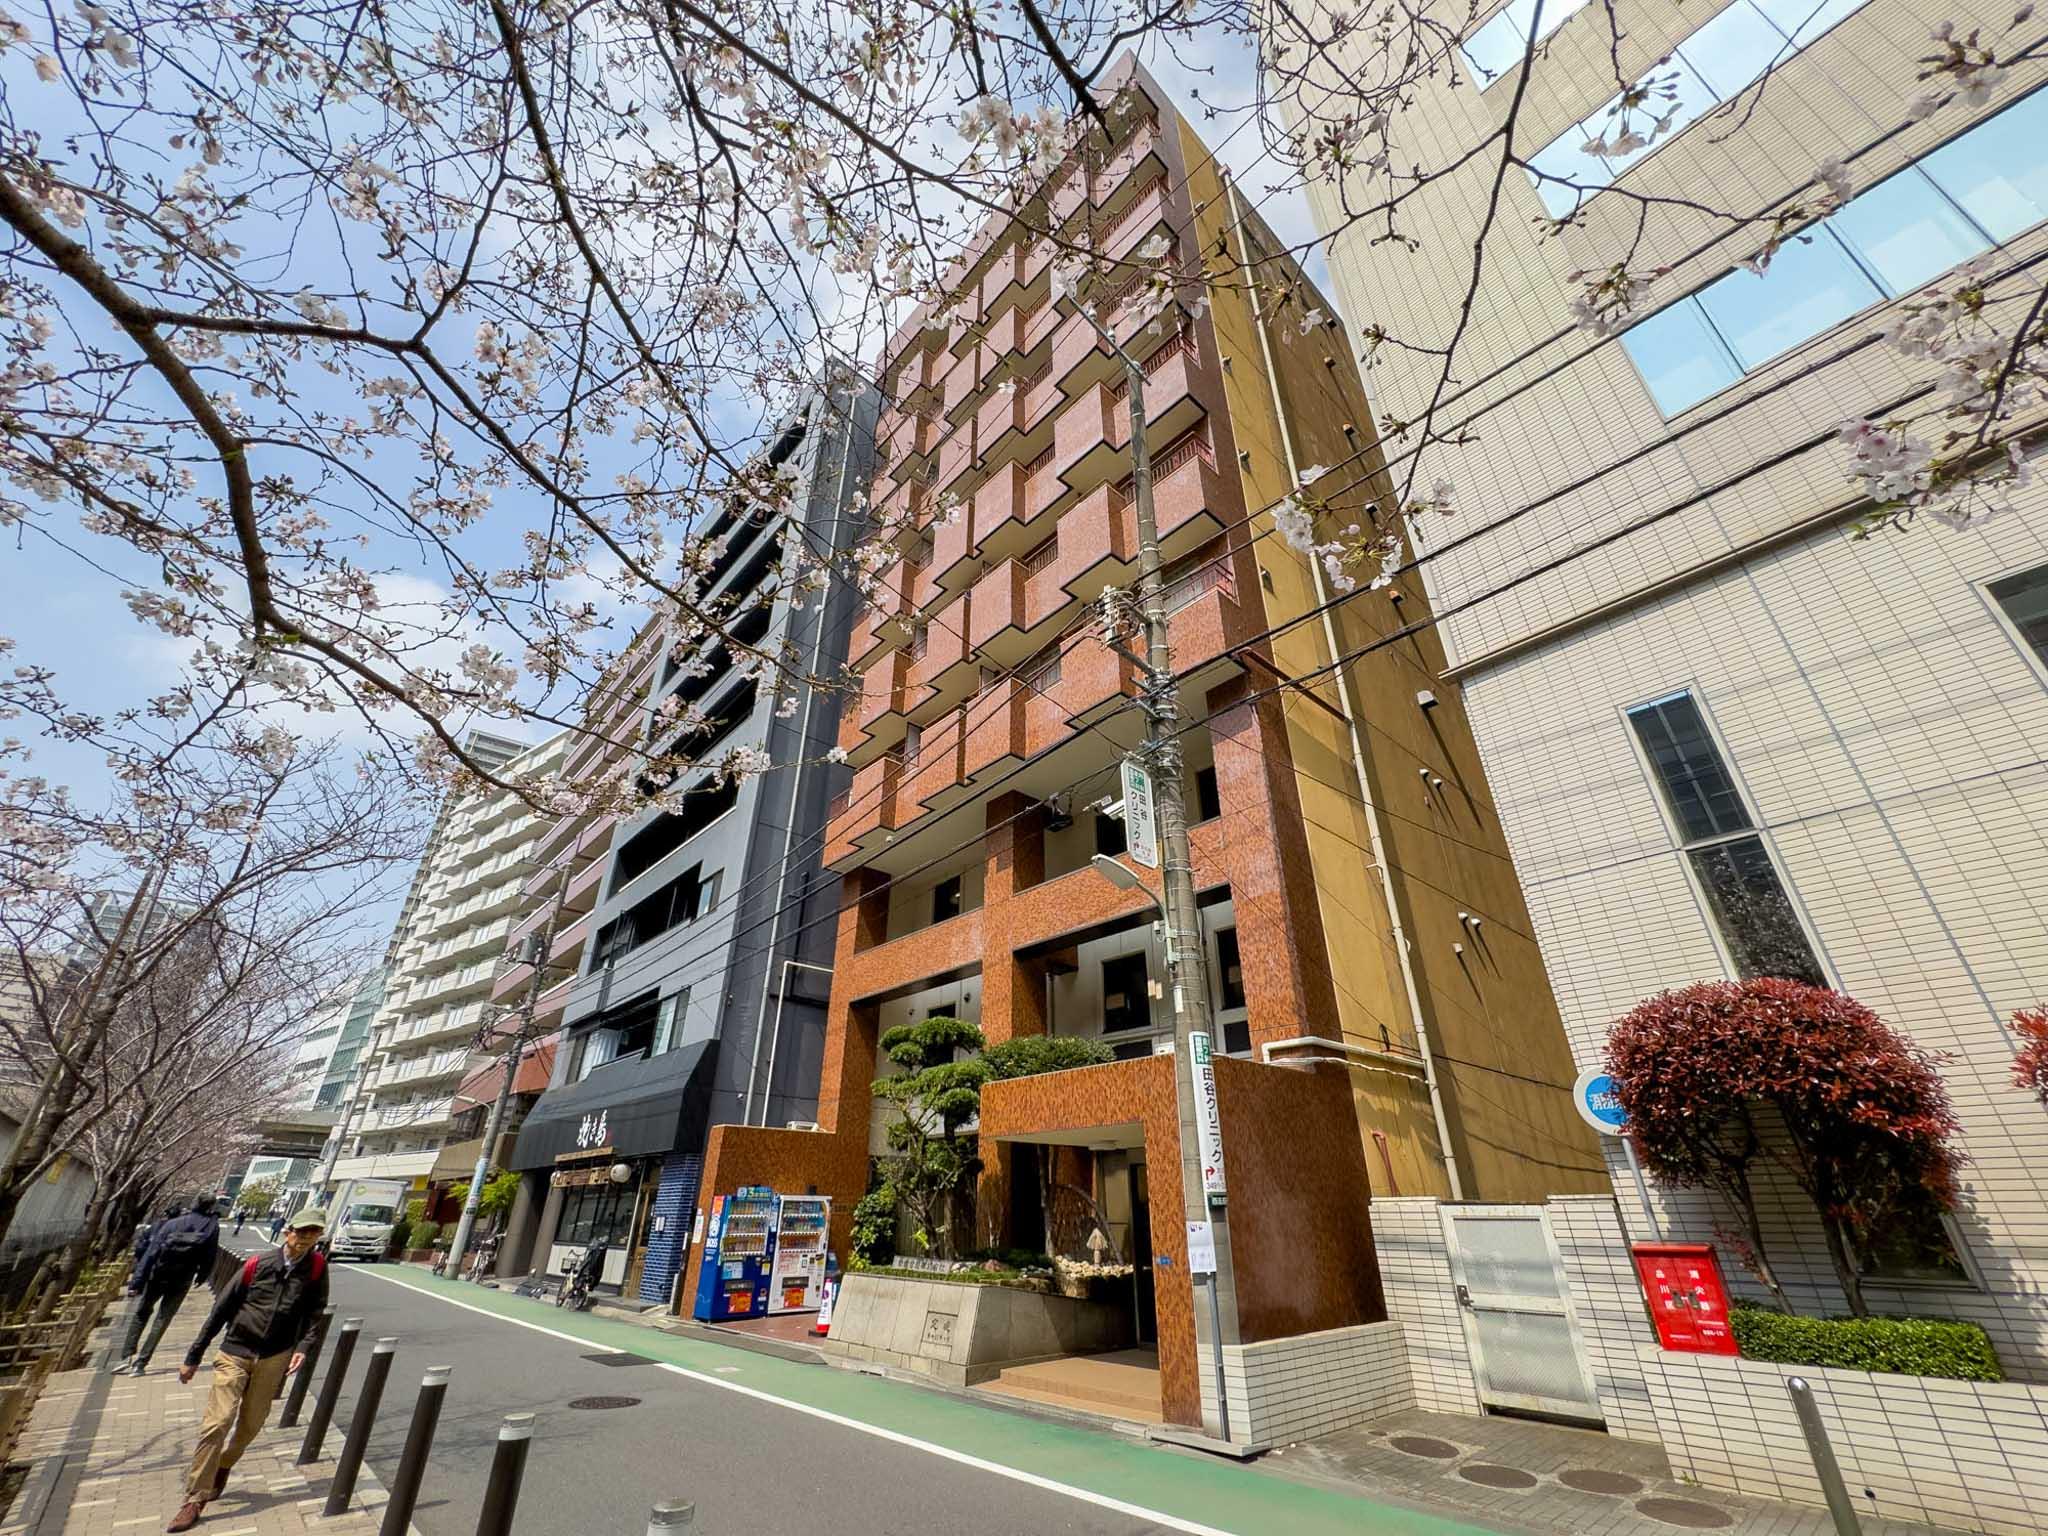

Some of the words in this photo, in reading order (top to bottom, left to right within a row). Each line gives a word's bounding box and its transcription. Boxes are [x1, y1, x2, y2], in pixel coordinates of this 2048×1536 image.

[1130, 792, 1141, 840] クリニック
[1138, 793, 1148, 821] 田谷
[1202, 1067, 1222, 1163] 田谷クリニック
[706, 1237, 718, 1248] BOSS
